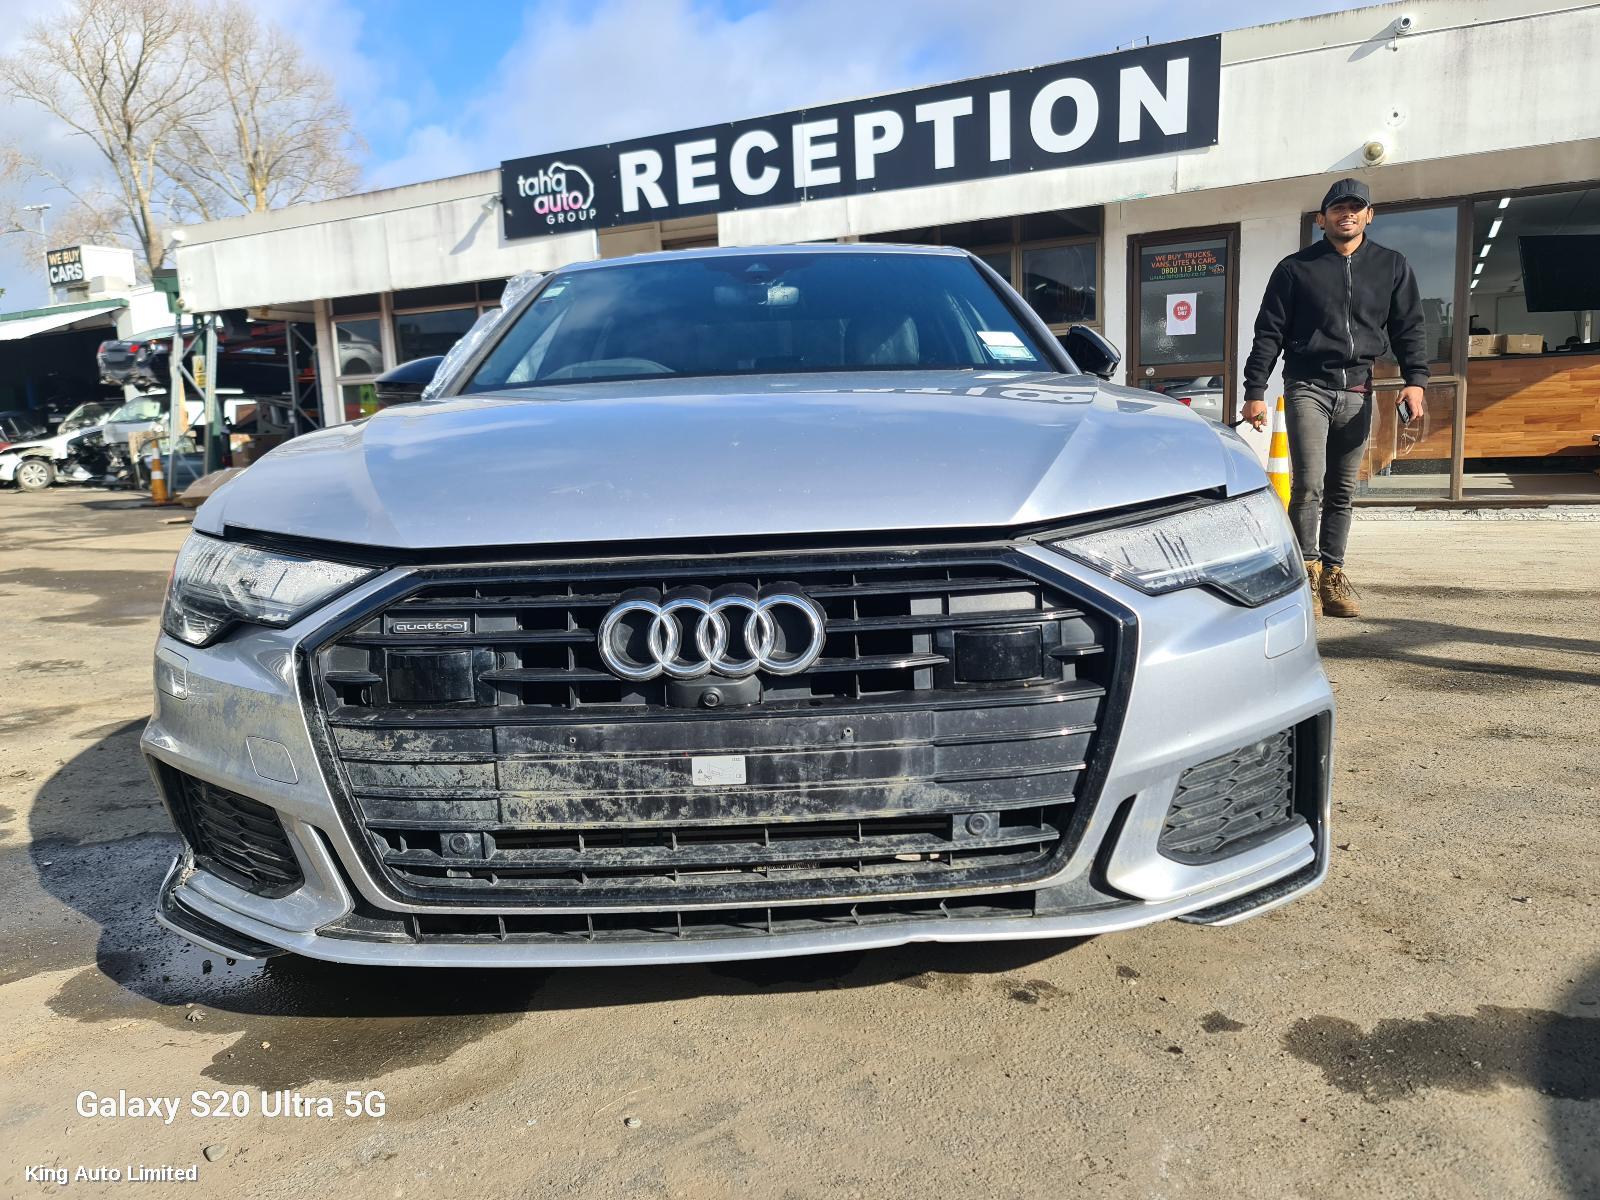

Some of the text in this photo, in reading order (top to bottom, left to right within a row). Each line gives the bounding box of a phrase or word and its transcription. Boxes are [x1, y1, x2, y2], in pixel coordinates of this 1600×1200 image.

[618, 56, 1191, 213] RECEPTION
[517, 169, 567, 197] taha
[534, 190, 583, 214] auto
[546, 209, 597, 225] GROUP
[48, 250, 79, 265] WE BUY
[1167, 253, 1181, 261] BUY
[50, 262, 83, 283] CARS
[1180, 265, 1192, 273] 113
[1194, 264, 1207, 272] 103
[396, 622, 463, 631] quattro
